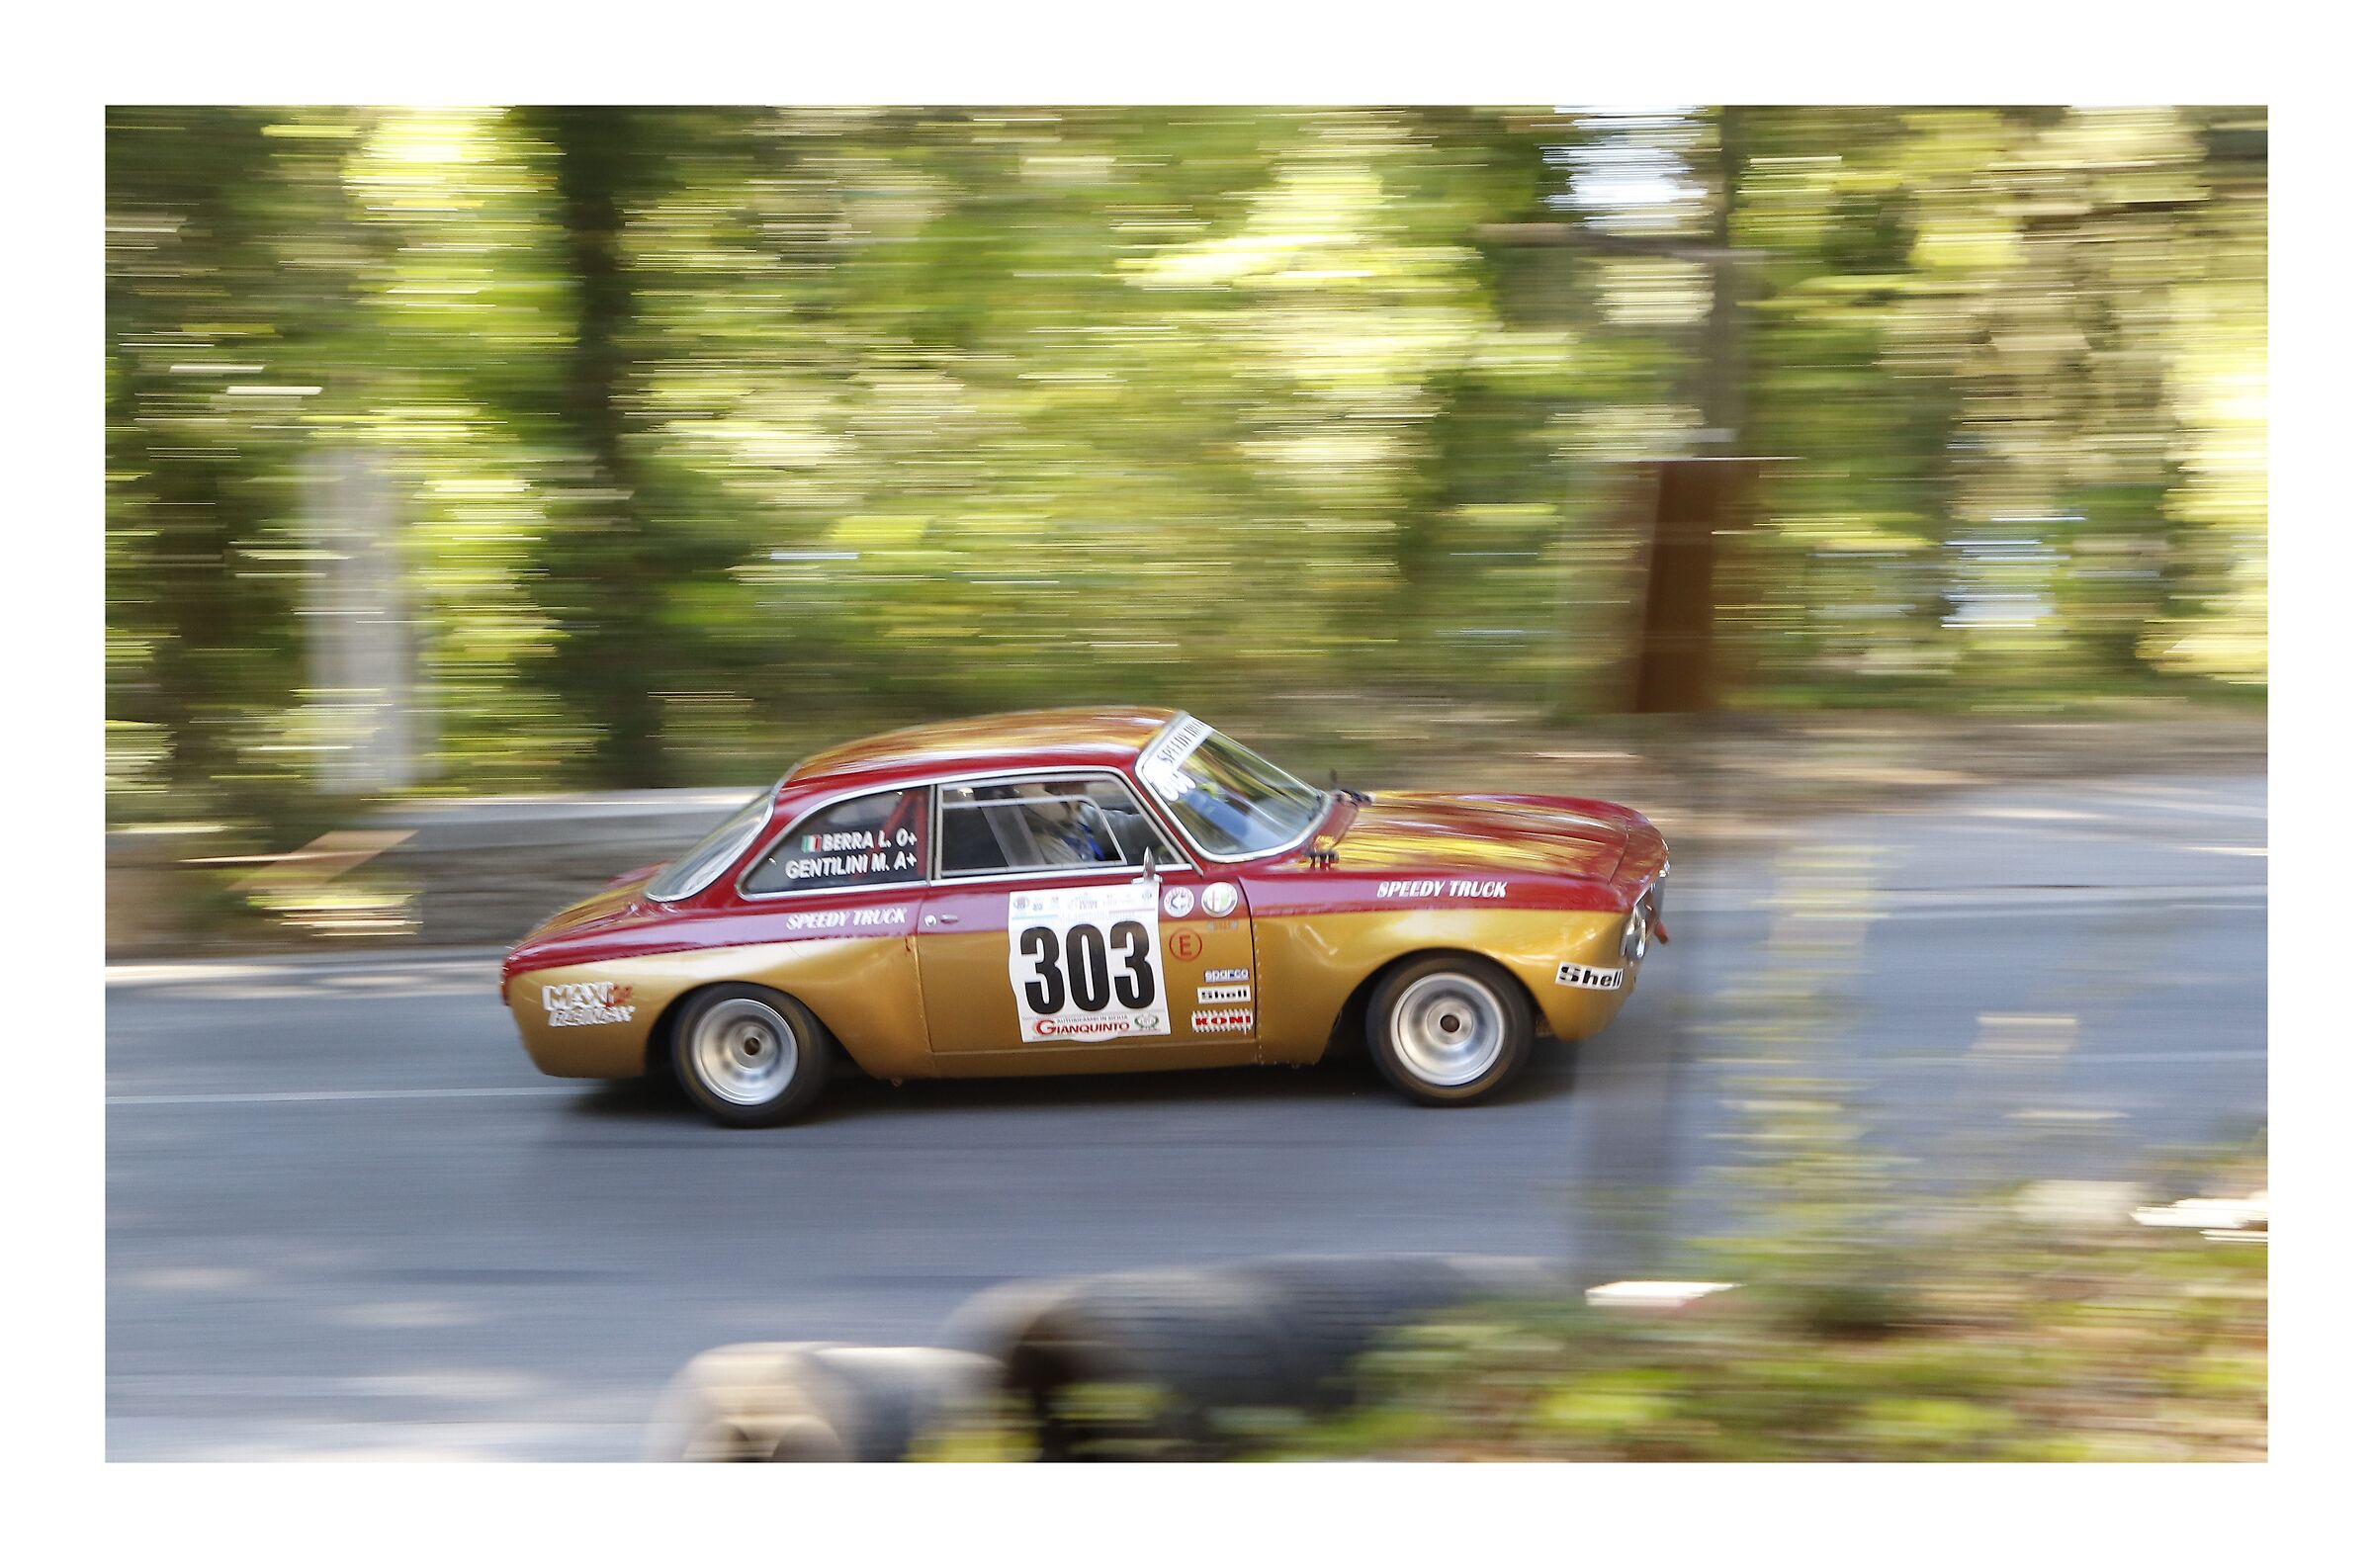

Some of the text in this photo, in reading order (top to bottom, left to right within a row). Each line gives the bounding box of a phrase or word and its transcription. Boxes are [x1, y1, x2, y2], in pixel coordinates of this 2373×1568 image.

[822, 830, 874, 852] BERRA
[877, 829, 891, 848] L.
[785, 850, 918, 880] GENTILINI M. A+
[1376, 880, 1508, 899] SPEEDY TRUCK
[786, 907, 908, 930] SPEEDY TRUCK
[1179, 934, 1192, 956] E
[1019, 920, 1156, 1015] 303
[1204, 969, 1249, 982] sparco
[1559, 966, 1622, 987] Shell
[1201, 989, 1247, 1001] Shell
[1034, 1019, 1130, 1036] GIANQUINTO
[1195, 1015, 1251, 1026] KONI
